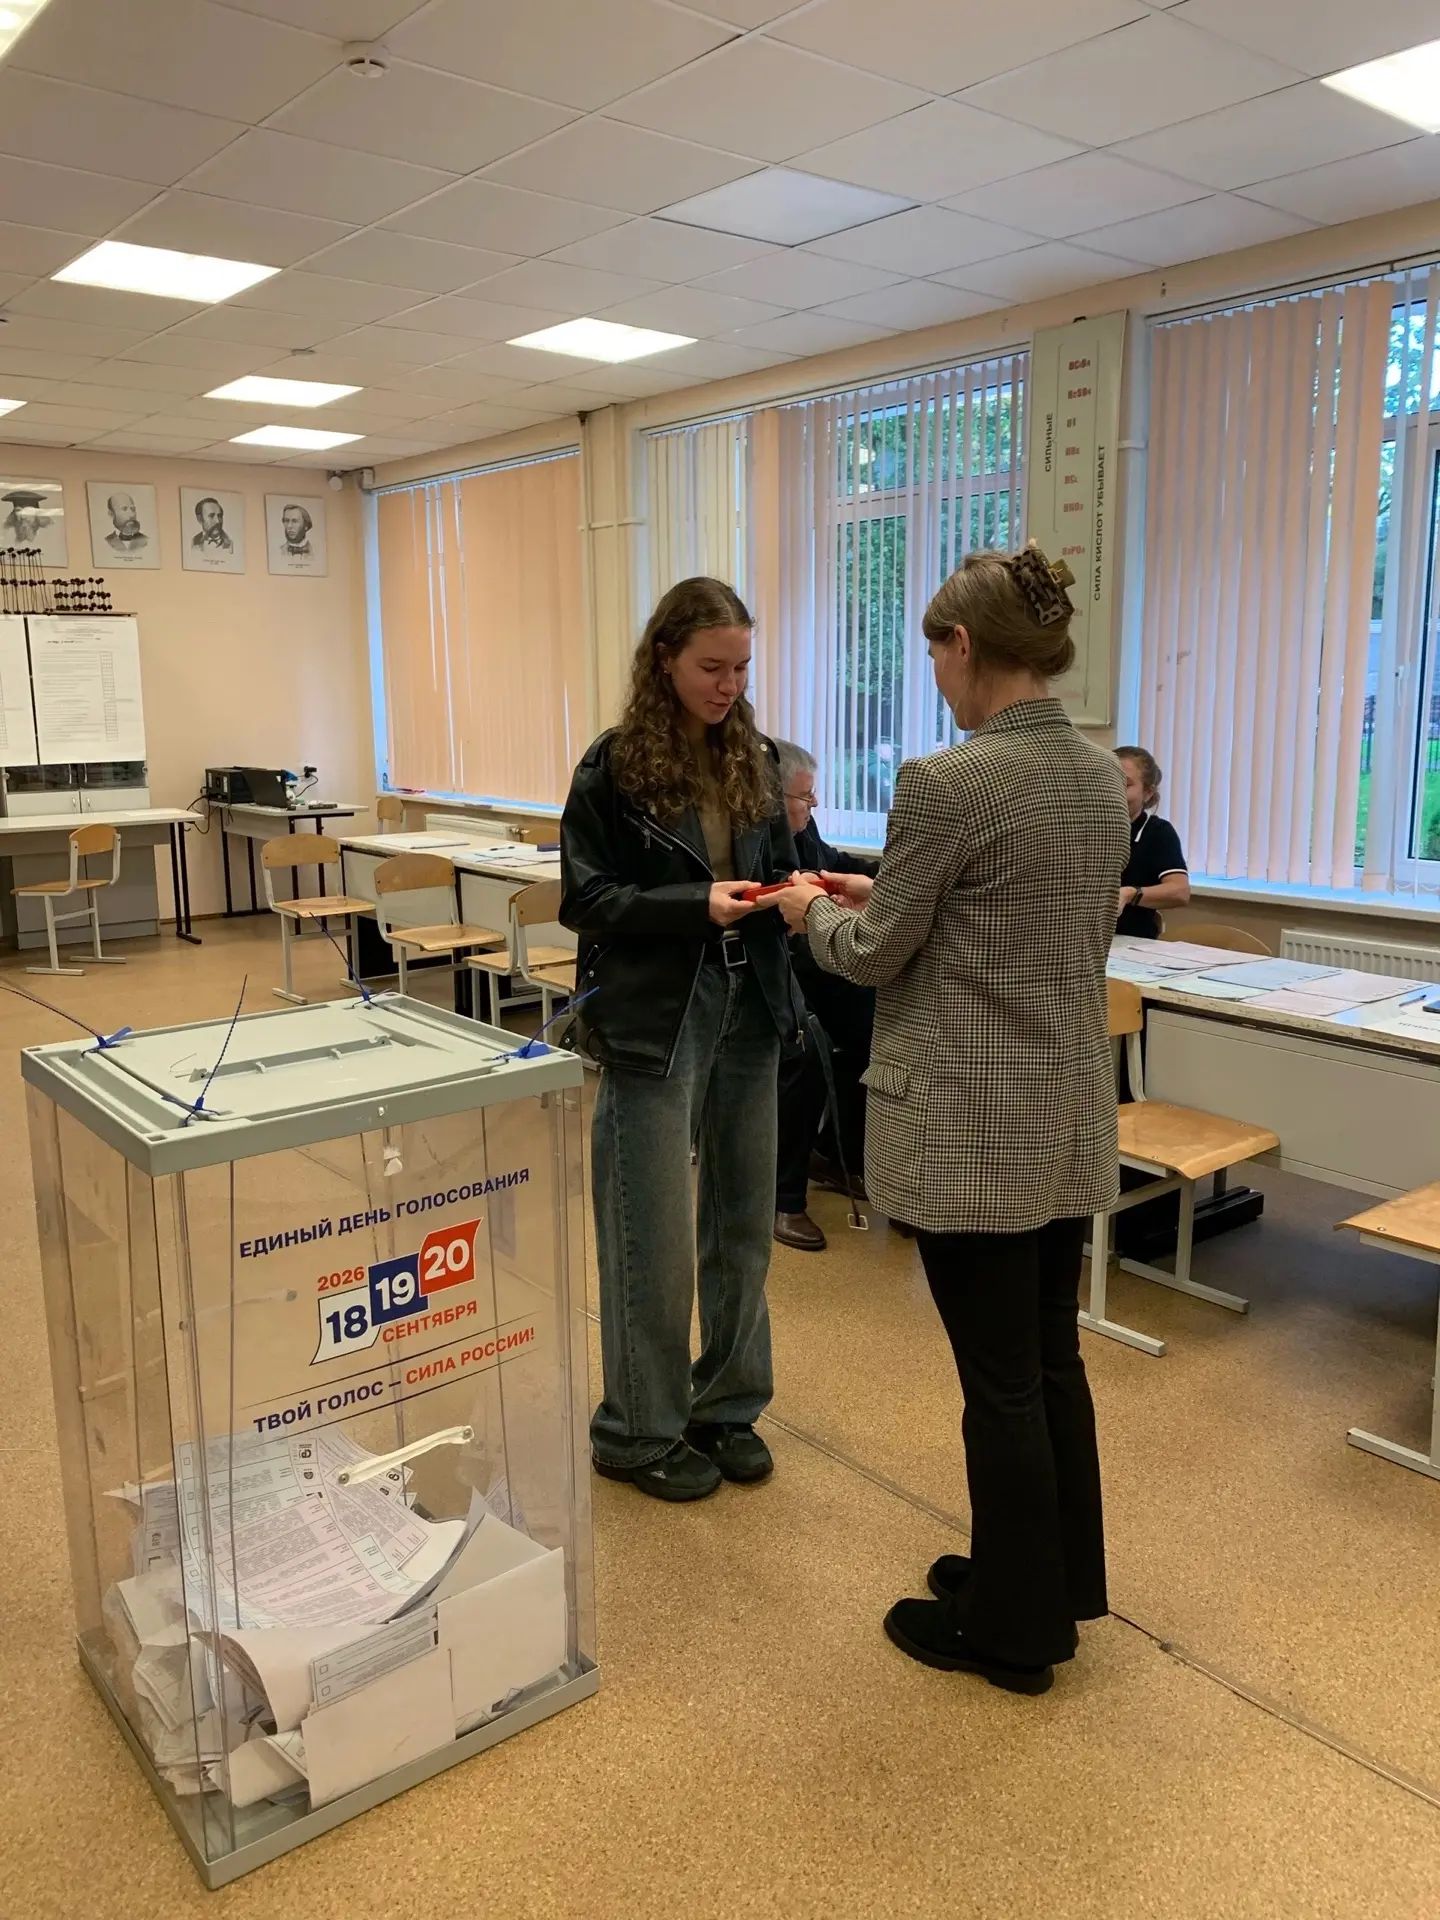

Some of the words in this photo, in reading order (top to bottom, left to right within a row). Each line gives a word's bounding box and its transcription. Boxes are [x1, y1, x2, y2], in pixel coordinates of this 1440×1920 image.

[1044, 412, 1054, 472] СИЛЬНЫЕ
[1096, 444, 1106, 507] УБЫВАЕТ
[1095, 511, 1104, 562] КИСЛОТ
[1093, 566, 1102, 601] СИЛА
[239, 1217, 333, 1259] ЕДИНЫЙ
[337, 1206, 391, 1236] ДЕНЬ
[396, 1168, 530, 1218] ГОЛОСОВАНИЯ
[317, 1265, 365, 1292] 2026
[325, 1303, 369, 1344] 18
[375, 1270, 416, 1311] 19
[423, 1238, 471, 1281] 20
[381, 1300, 478, 1344] СЕНТЯБРЯ
[253, 1400, 312, 1434] ТВОЙ
[316, 1380, 384, 1415] ГОЛОС
[405, 1356, 457, 1386] СИЛА
[460, 1327, 536, 1367] РОССИИ!
